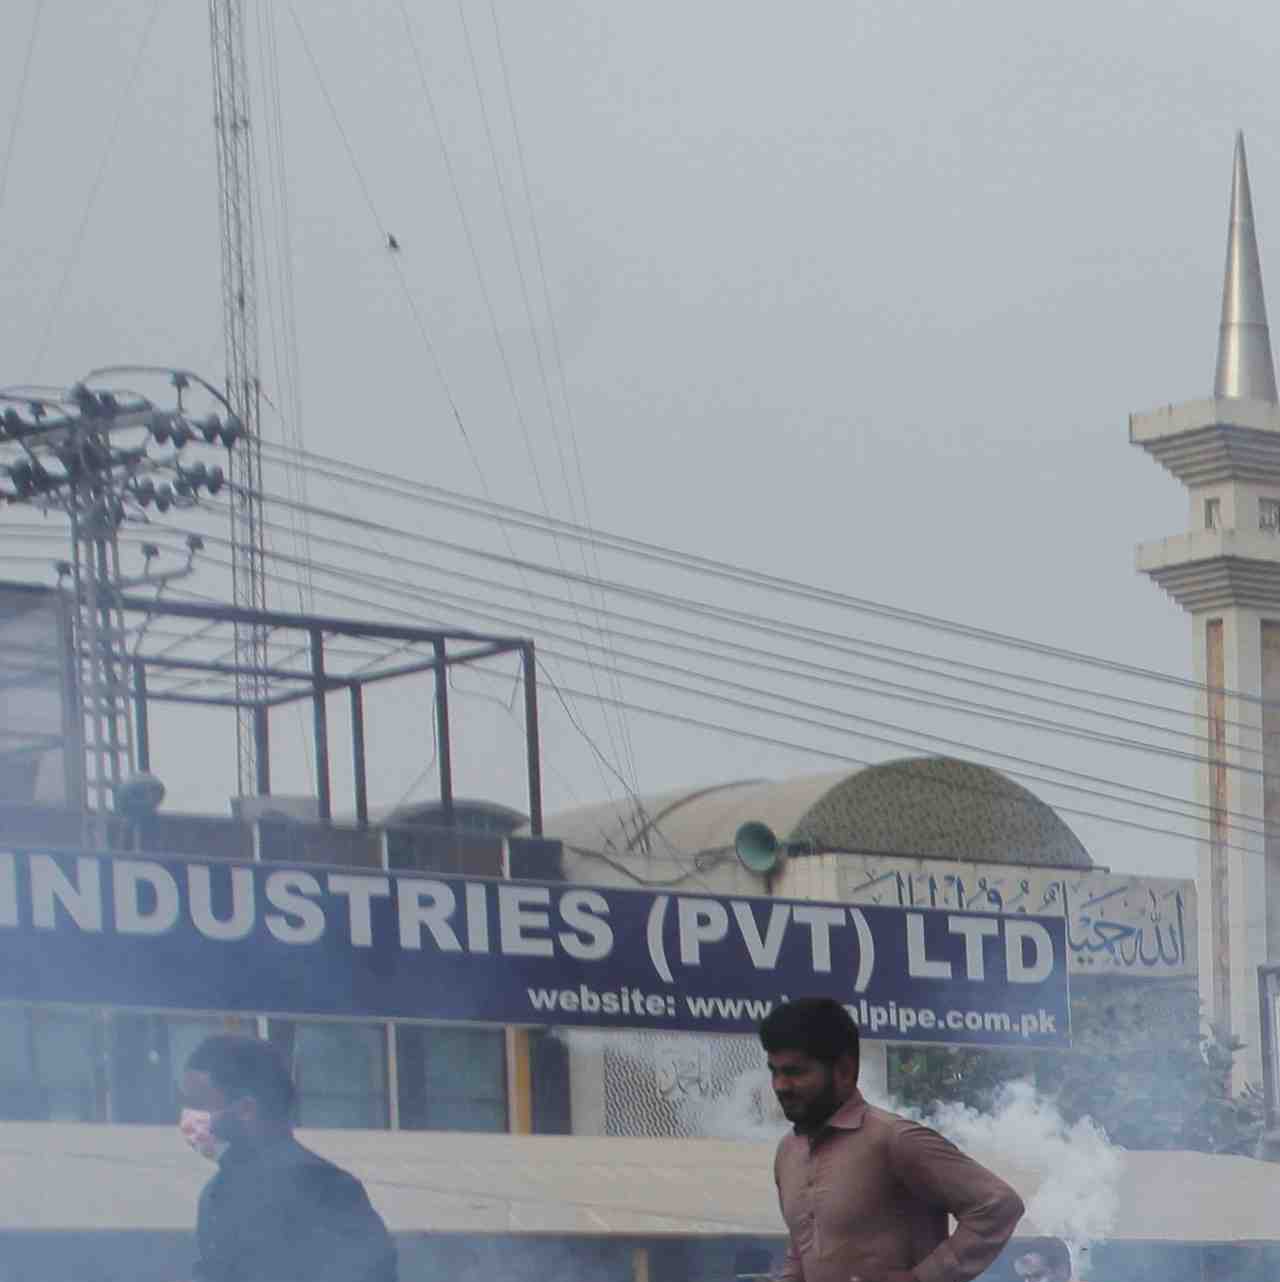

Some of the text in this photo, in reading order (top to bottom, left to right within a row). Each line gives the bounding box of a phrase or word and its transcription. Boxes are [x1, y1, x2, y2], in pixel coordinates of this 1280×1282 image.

[0, 853, 1054, 993] INDUSTRIES (PVT) LTD
[527, 984, 676, 1017] website:
